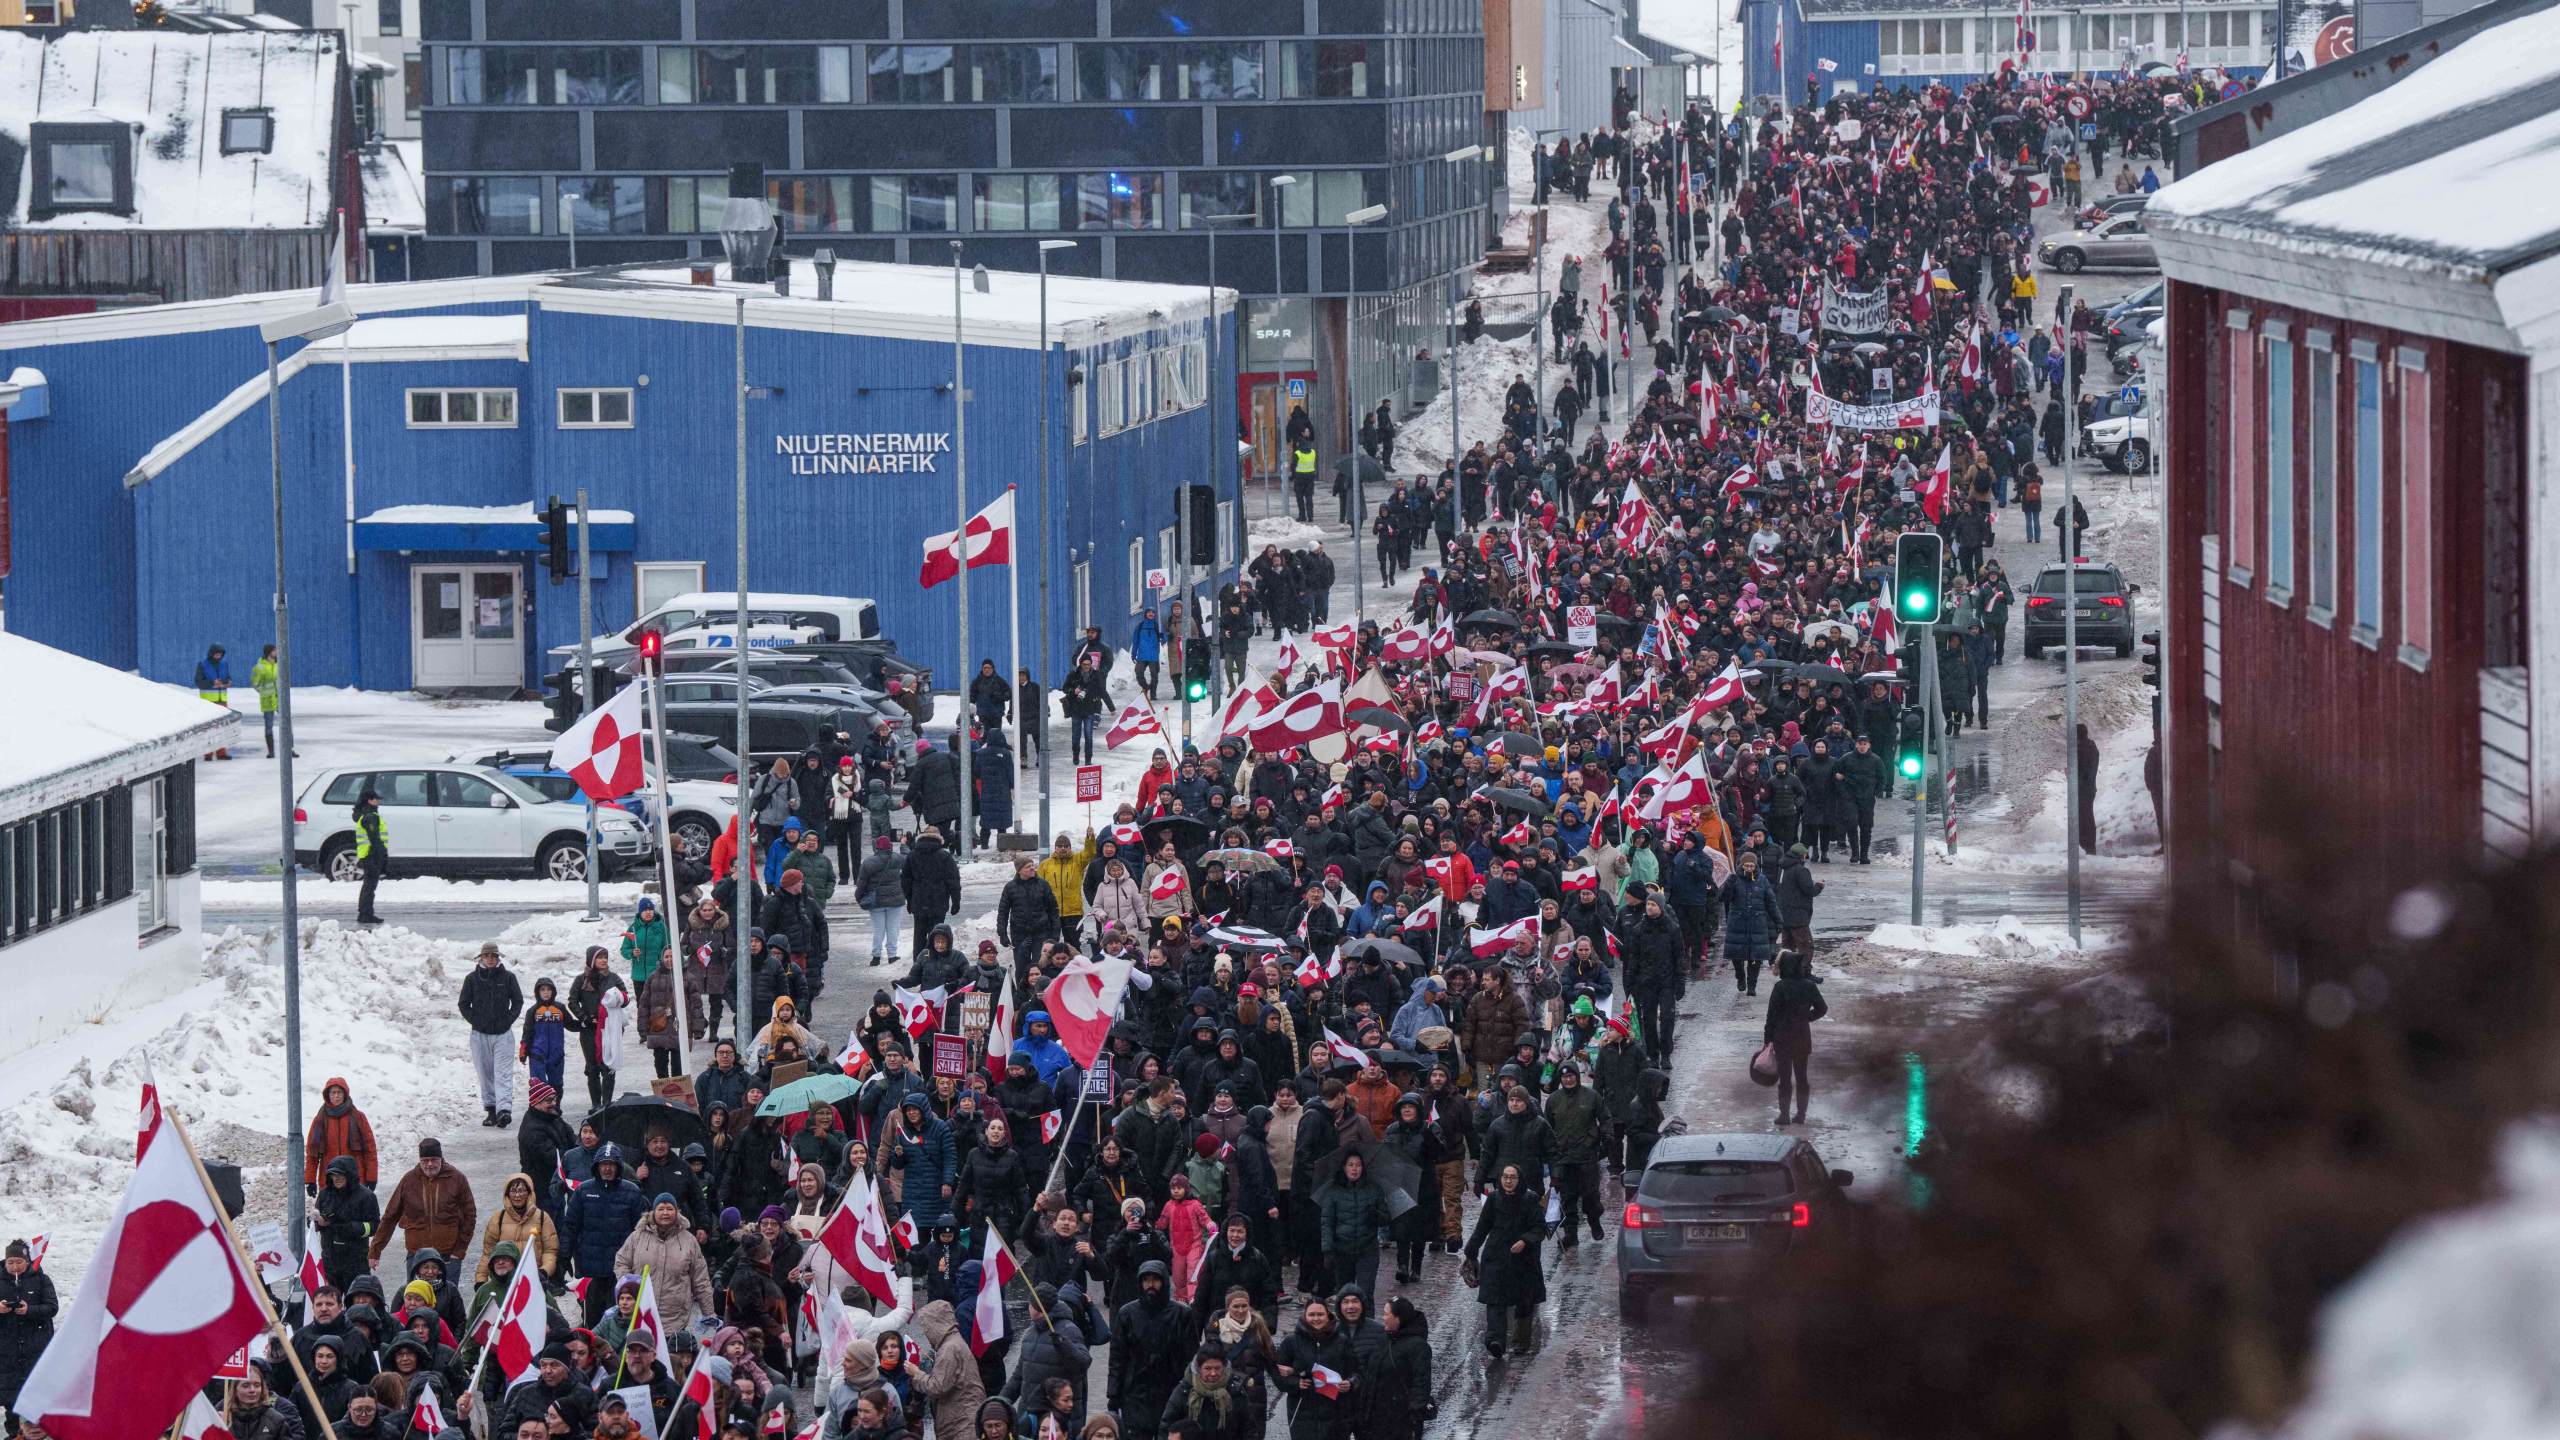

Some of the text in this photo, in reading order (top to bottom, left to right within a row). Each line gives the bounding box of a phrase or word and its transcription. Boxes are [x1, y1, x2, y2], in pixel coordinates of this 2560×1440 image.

[1826, 307, 1850, 328] GO
[1256, 328, 1292, 339] SPAR
[1908, 393, 1939, 410] OUR
[777, 433, 950, 455] NIUERNERMIK
[791, 454, 936, 475] ILINNIARFIK
[1080, 785, 1099, 797] SALE!
[964, 1010, 990, 1028] NO!
[937, 1059, 962, 1074] SALE!
